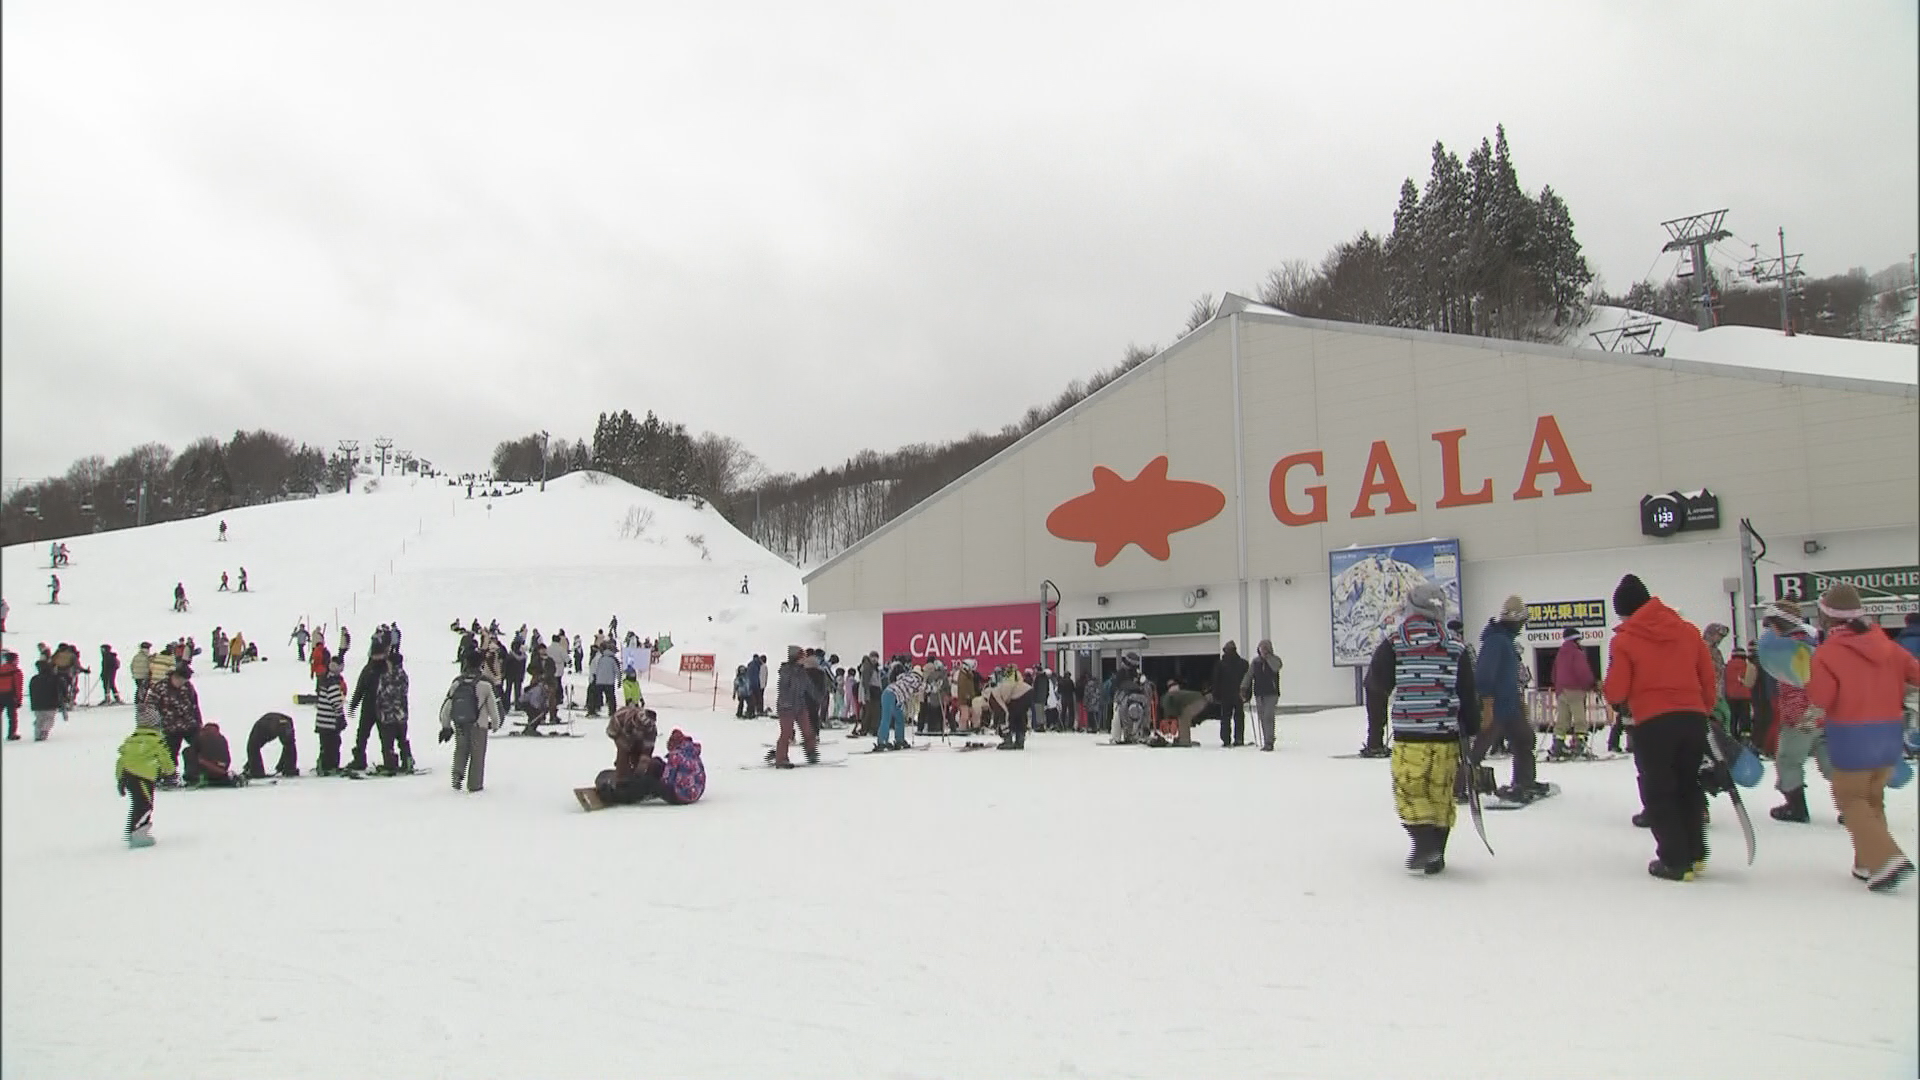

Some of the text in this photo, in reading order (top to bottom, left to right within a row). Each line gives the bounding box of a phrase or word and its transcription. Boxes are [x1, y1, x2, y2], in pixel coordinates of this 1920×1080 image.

[1269, 414, 1592, 527] GALA
[1095, 619, 1136, 631] SOCIABLE
[909, 629, 1023, 658] CANMAKE
[1527, 632, 1549, 641] OPEN
